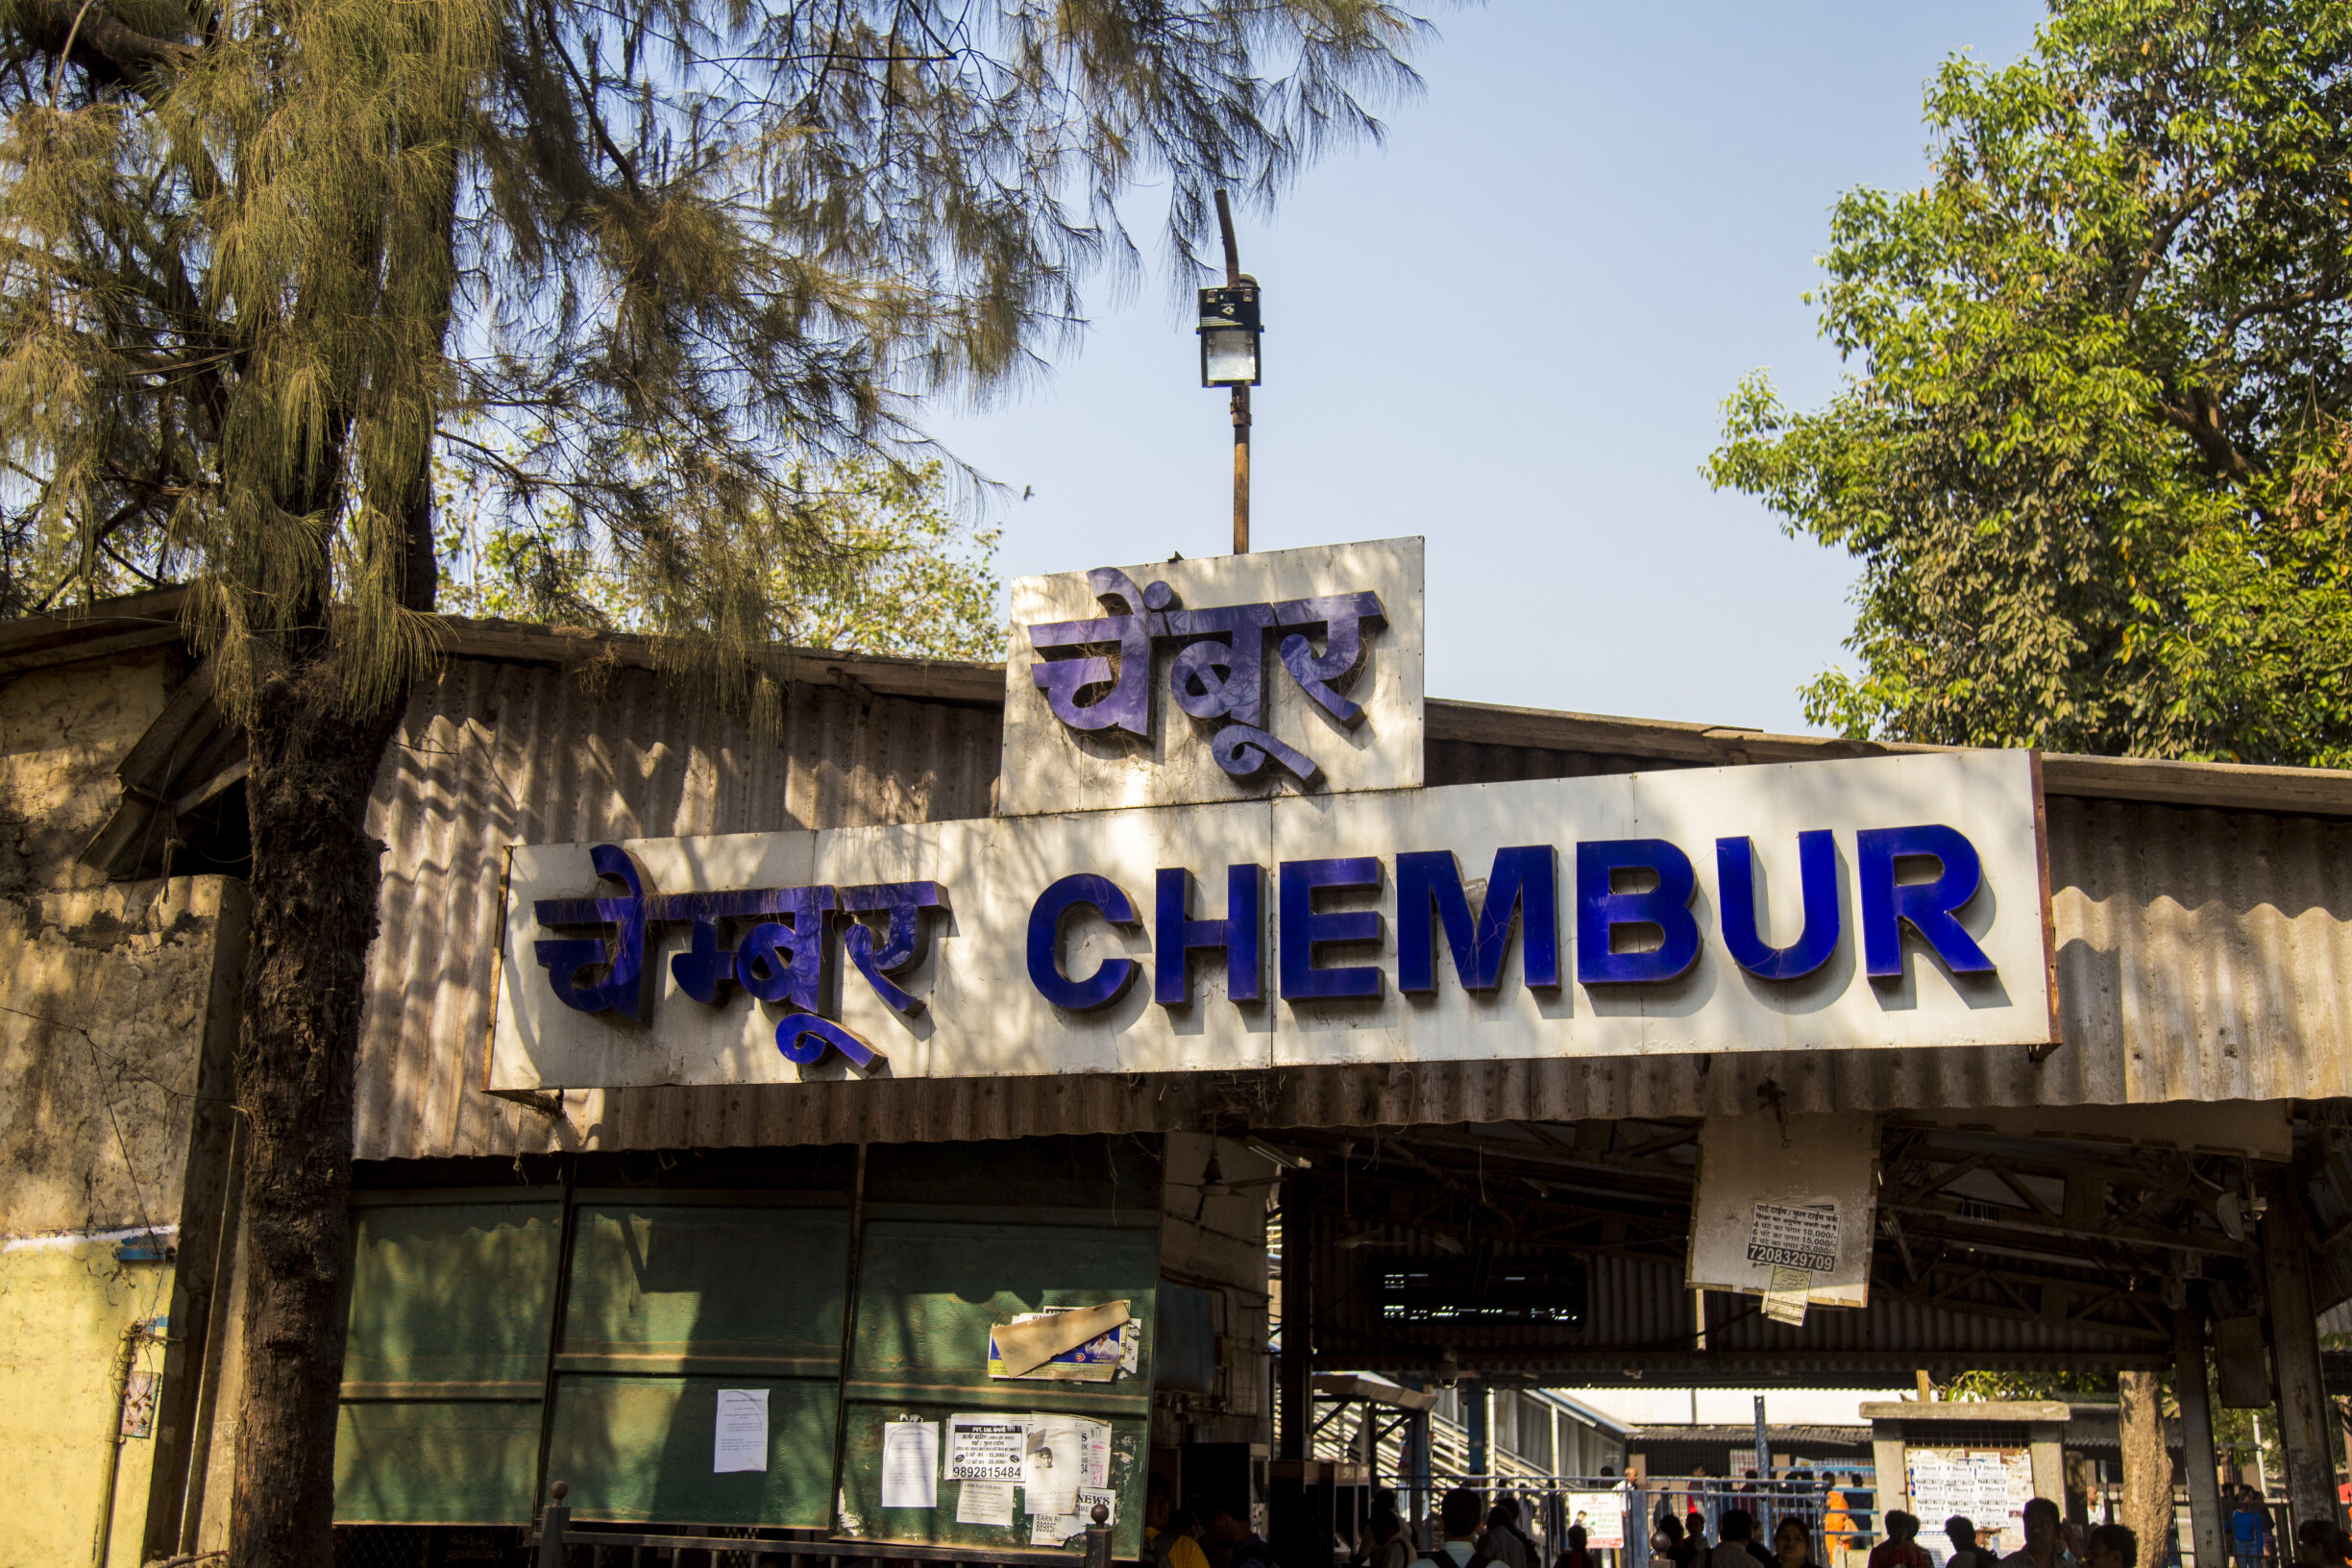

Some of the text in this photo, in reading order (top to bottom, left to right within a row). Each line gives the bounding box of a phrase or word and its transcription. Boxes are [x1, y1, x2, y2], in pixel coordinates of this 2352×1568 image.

[1028, 566, 1387, 790] चेंबूर
[1027, 824, 1997, 1013] CHEMBUR
[534, 845, 950, 1071] चेम्बूर
[1802, 1228, 1837, 1239] 10,000/-
[1802, 1237, 1836, 1247] 15,000/-
[1801, 1244, 1835, 1255] 25,000/-
[1750, 1245, 1833, 1271] 7208329709
[953, 1466, 1021, 1478] 9892815484
[1076, 1494, 1110, 1506] NEWS
